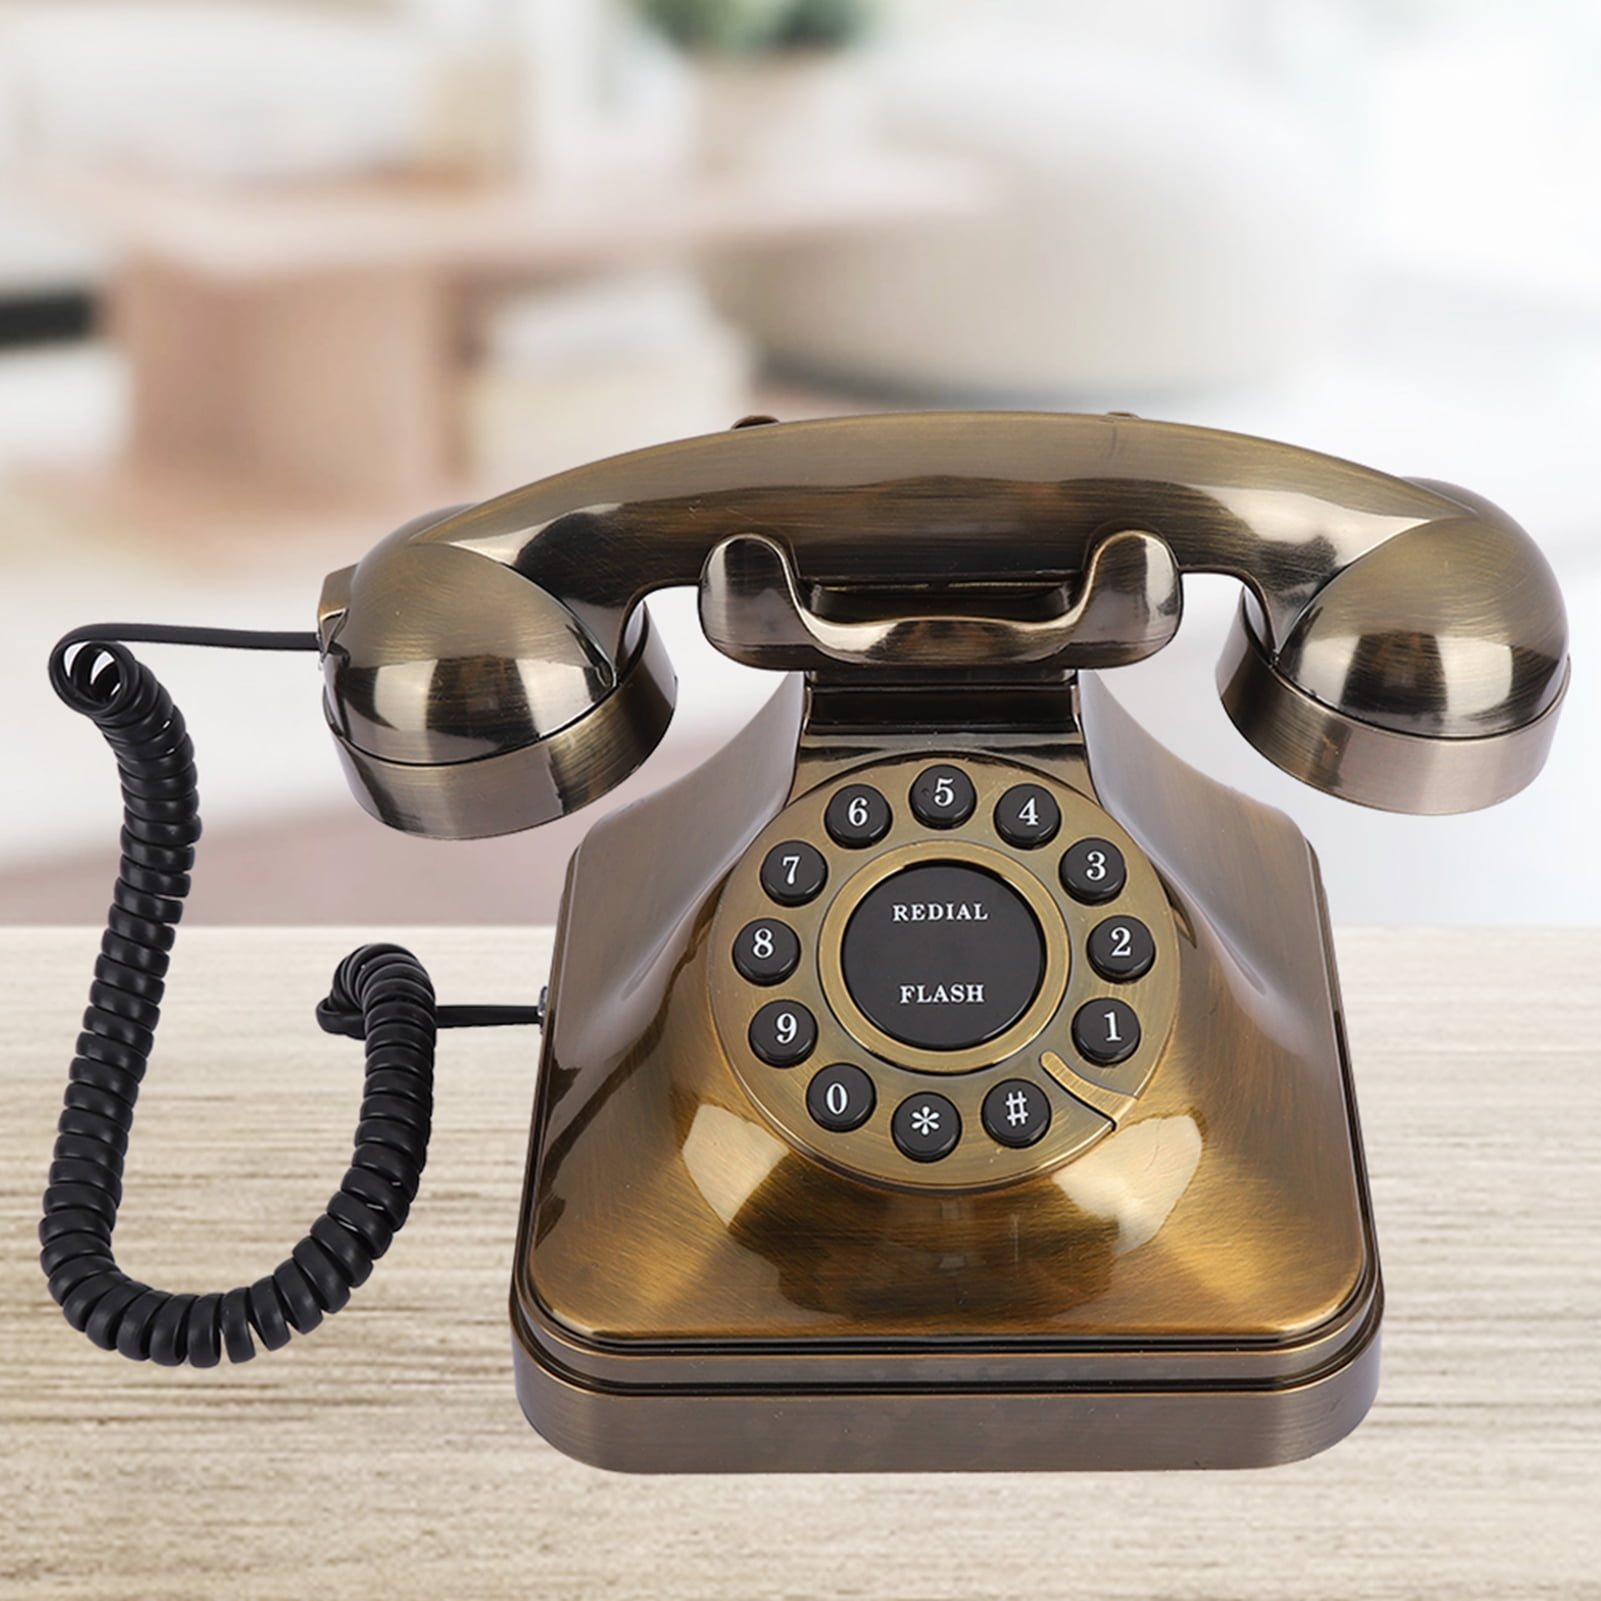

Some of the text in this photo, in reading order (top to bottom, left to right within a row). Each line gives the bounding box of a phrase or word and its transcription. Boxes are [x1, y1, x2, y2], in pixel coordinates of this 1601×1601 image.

[934, 777, 954, 807] 5
[848, 797, 868, 827] 6
[1018, 797, 1039, 826] 4
[782, 855, 800, 885] 7
[1086, 850, 1106, 881] 3
[892, 903, 989, 922] REDIAL
[752, 928, 774, 959] 8
[1111, 927, 1132, 957] 2
[899, 983, 985, 1004] FLASH
[776, 1012, 797, 1044] 9
[1103, 1011, 1122, 1042] 1
[826, 1082, 848, 1115] 0
[1005, 1090, 1029, 1127] #
